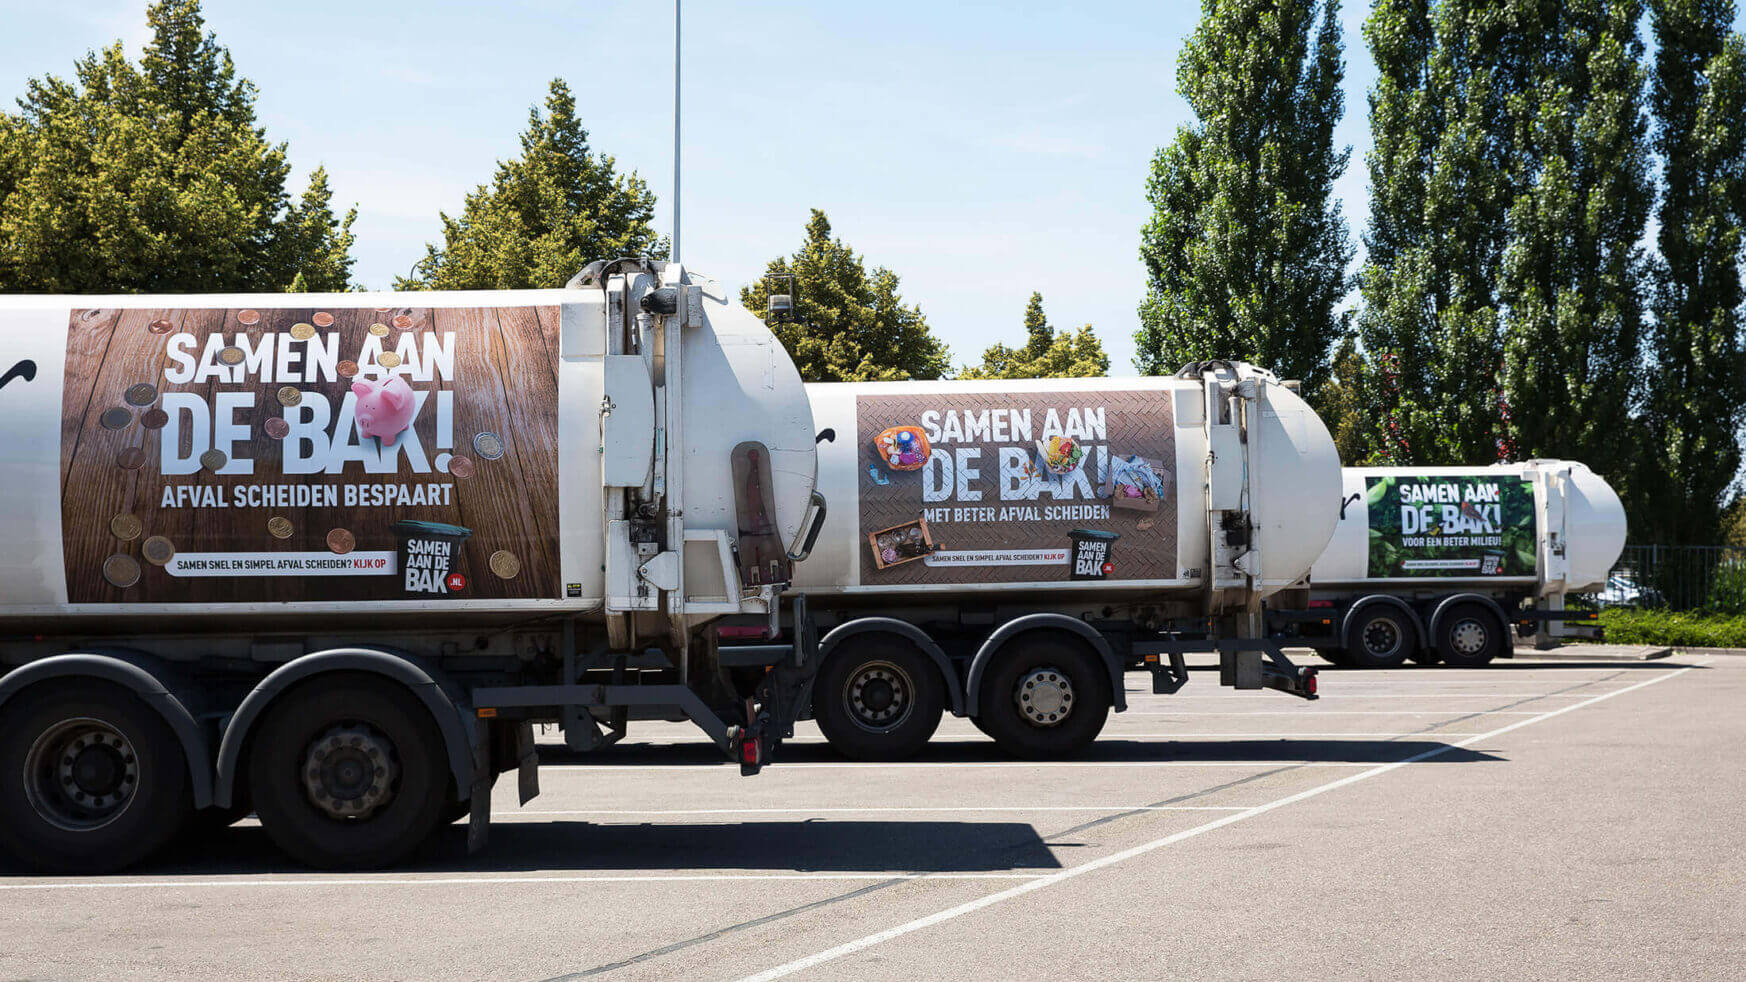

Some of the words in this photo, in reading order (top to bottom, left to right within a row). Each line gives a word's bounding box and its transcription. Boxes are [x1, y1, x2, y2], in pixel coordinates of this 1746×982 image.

[164, 332, 341, 384] SAMEN
[352, 331, 456, 382] AAN
[160, 391, 255, 475] DE
[921, 408, 1032, 443] SAMEN
[1042, 407, 1107, 441] AAN
[922, 447, 983, 502] DE
[161, 485, 228, 508] AFVAL
[234, 484, 338, 508] SCHEIDEN
[344, 483, 453, 506] BESPAART
[1400, 483, 1460, 503] SAMEN
[1464, 483, 1500, 503] AAN
[923, 507, 951, 523] MET
[954, 507, 996, 522] BETER
[999, 506, 1042, 522] AFVAL
[1044, 505, 1110, 521] SCHEIDEN
[1401, 504, 1434, 535] DE
[407, 538, 451, 556] SAMEN
[1078, 540, 1107, 552] SAMEN
[1402, 537, 1425, 547] VOOR
[1426, 537, 1442, 547] EEN
[1443, 536, 1469, 547] BETER
[1470, 536, 1502, 546] MILIEU!
[177, 560, 208, 570] SAMEN
[208, 560, 230, 570] SNEL
[232, 559, 243, 570] EN
[244, 559, 275, 569] SIMPEL
[277, 559, 304, 569] AFVAL
[305, 559, 352, 569] SCHEIDEN?
[353, 558, 373, 569] KIJK
[374, 558, 386, 569] OP
[406, 554, 433, 569] AAN
[434, 555, 450, 570] DE
[1077, 550, 1096, 561] AAN
[1095, 551, 1106, 561] DE
[1075, 559, 1104, 576] BAK
[405, 568, 448, 594] BAK
